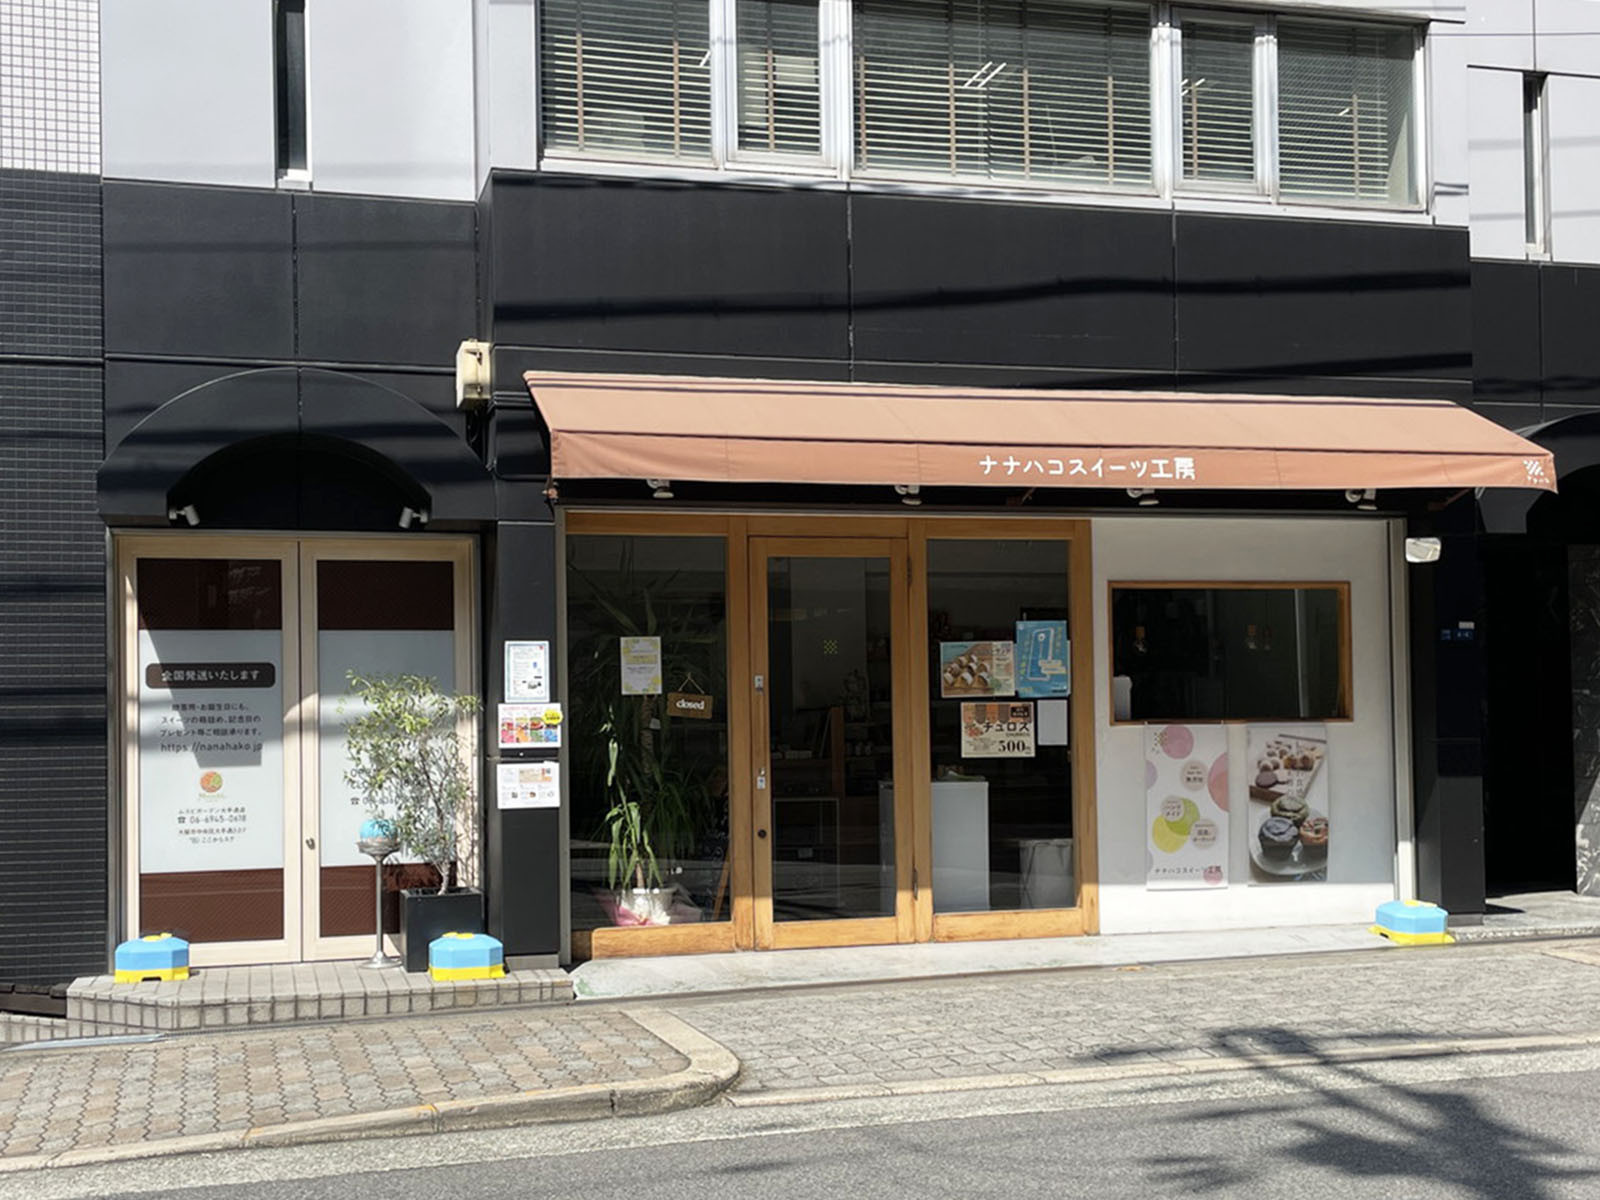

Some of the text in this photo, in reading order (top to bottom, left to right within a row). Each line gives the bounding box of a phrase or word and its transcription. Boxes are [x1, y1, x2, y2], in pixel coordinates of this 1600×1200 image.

[979, 455, 1196, 480] ナナハコスイーツ工房
[161, 670, 260, 682] 全国発送いたします
[676, 696, 705, 710] closed
[983, 722, 1030, 733] チュロス
